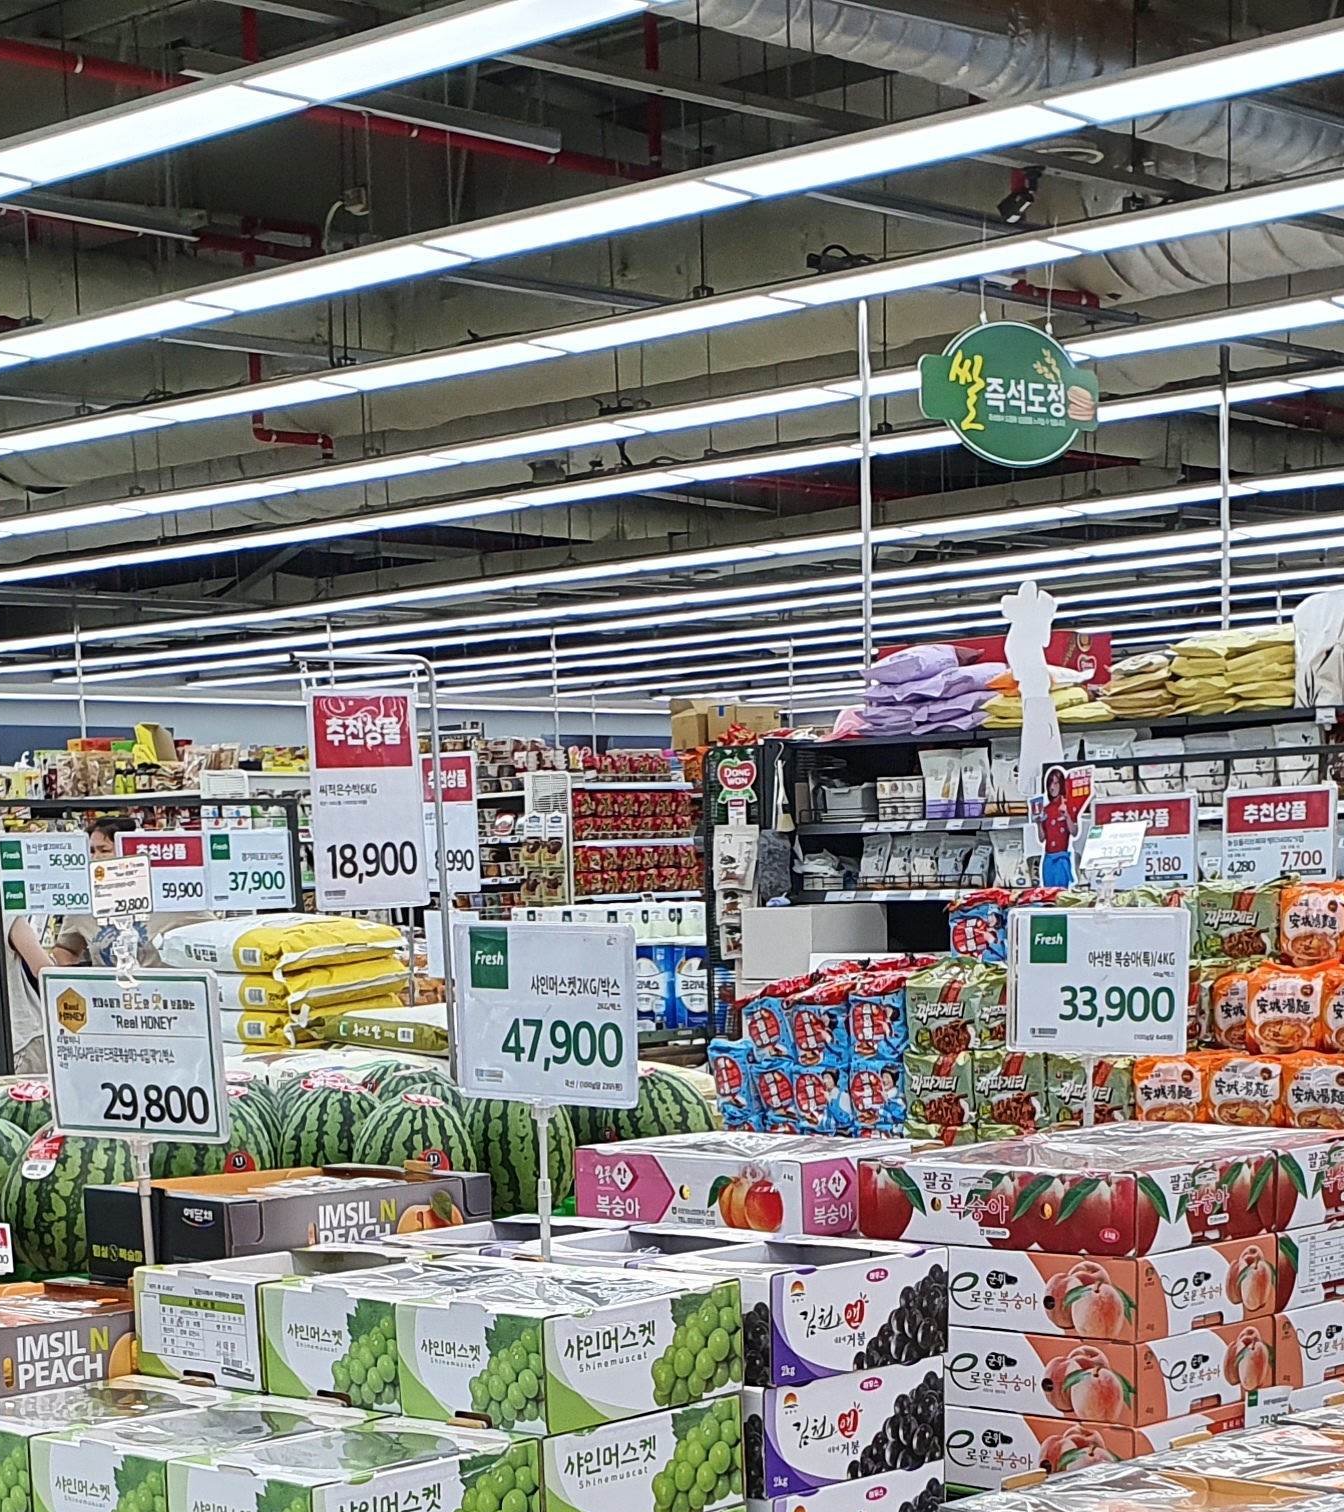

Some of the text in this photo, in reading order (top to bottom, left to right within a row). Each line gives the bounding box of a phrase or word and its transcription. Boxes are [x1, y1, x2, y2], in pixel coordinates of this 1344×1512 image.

[985, 377, 1066, 417] 즉석도정
[325, 714, 401, 749] 추천상품
[723, 767, 751, 778] DONG
[727, 777, 748, 786] WON
[1243, 801, 1308, 823] 추천상품
[2, 851, 21, 860] Fresh
[48, 853, 86, 869] 56,900
[327, 840, 418, 885] 18,900
[1145, 856, 1181, 873] 5,180
[1280, 850, 1323, 871] 7,700
[1227, 860, 1256, 875] 4,280
[162, 881, 204, 901] 59,900
[228, 870, 286, 895] 37,900
[52, 893, 89, 909] 58,900
[114, 897, 149, 912] 29,800
[1205, 910, 1259, 930] 짜파게티
[1034, 933, 1063, 946] Fresh
[474, 951, 505, 967] Fresh
[1088, 950, 1112, 968] 아삭한
[915, 1002, 965, 1019] 짜파게티
[1058, 985, 1176, 1028] 33,900
[501, 1017, 624, 1072] 47,900
[910, 1076, 958, 1096] 짜파게티
[975, 1075, 1028, 1096] 짜파게티
[101, 1081, 210, 1129] 29,800
[923, 1171, 953, 1191] 팔공
[318, 1201, 376, 1229] IMSIL
[596, 1194, 640, 1219] 복숭아
[813, 1202, 853, 1226] 복숭아
[946, 1194, 1009, 1225] 복숭아
[16, 1326, 109, 1363] IMSIL N
[286, 1322, 343, 1347] 샤인머스켓
[563, 1320, 657, 1364] 샤인머스켓
[18, 1353, 104, 1389] PEACH
[578, 1351, 648, 1374] Shinemuscat
[780, 1364, 796, 1377] 2kg
[563, 1434, 657, 1479] 샤인머스켓
[578, 1465, 649, 1490] Shinemuscat
